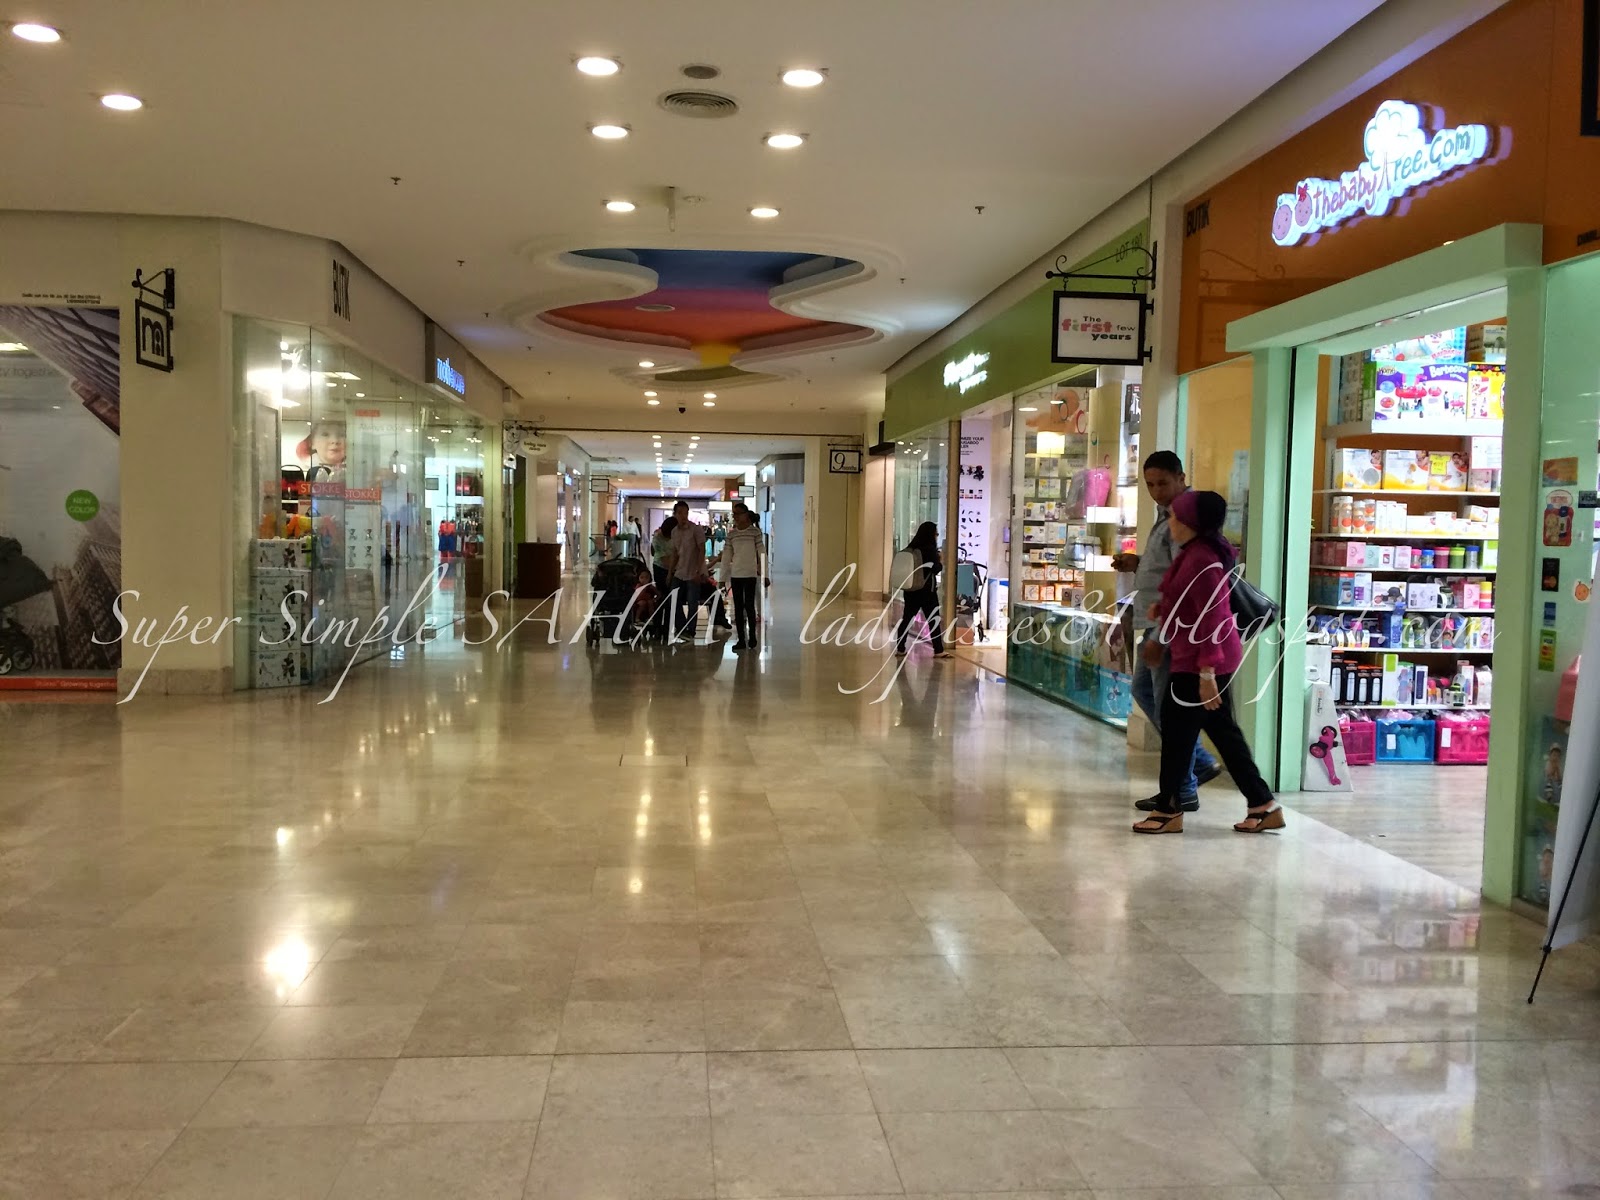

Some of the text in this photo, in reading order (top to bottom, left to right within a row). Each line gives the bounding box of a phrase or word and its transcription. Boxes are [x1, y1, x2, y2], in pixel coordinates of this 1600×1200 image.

[1082, 315, 1102, 323] The
[1061, 318, 1136, 333] first few
[1091, 332, 1132, 341] years
[832, 452, 846, 471] 9
[300, 483, 341, 494] STOKKE
[344, 489, 378, 499] STOKKE
